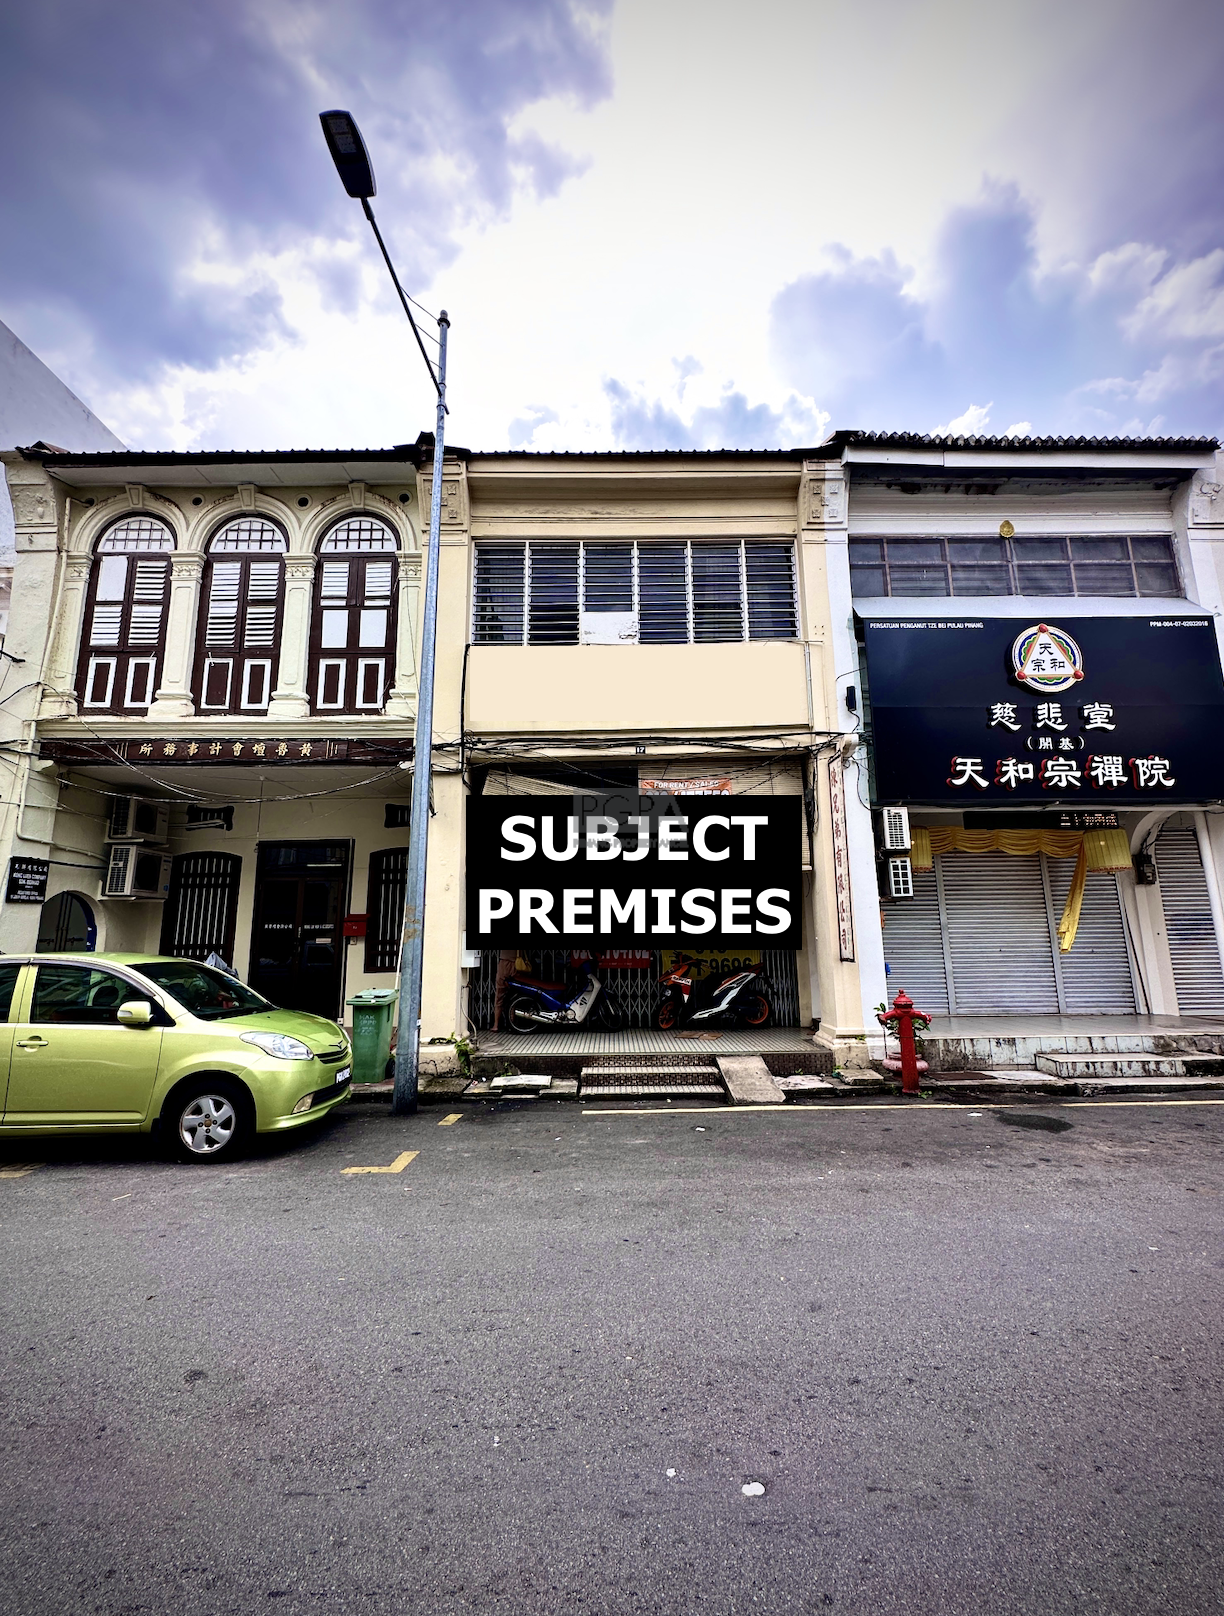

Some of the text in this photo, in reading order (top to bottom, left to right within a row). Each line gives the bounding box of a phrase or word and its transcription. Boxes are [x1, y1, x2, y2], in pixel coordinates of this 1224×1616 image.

[1038, 642, 1054, 656] 天
[989, 702, 1116, 732] 慈悲堂
[950, 756, 1176, 789] 天和宗禪院
[653, 781, 669, 789] FOR
[669, 781, 688, 789] RENT
